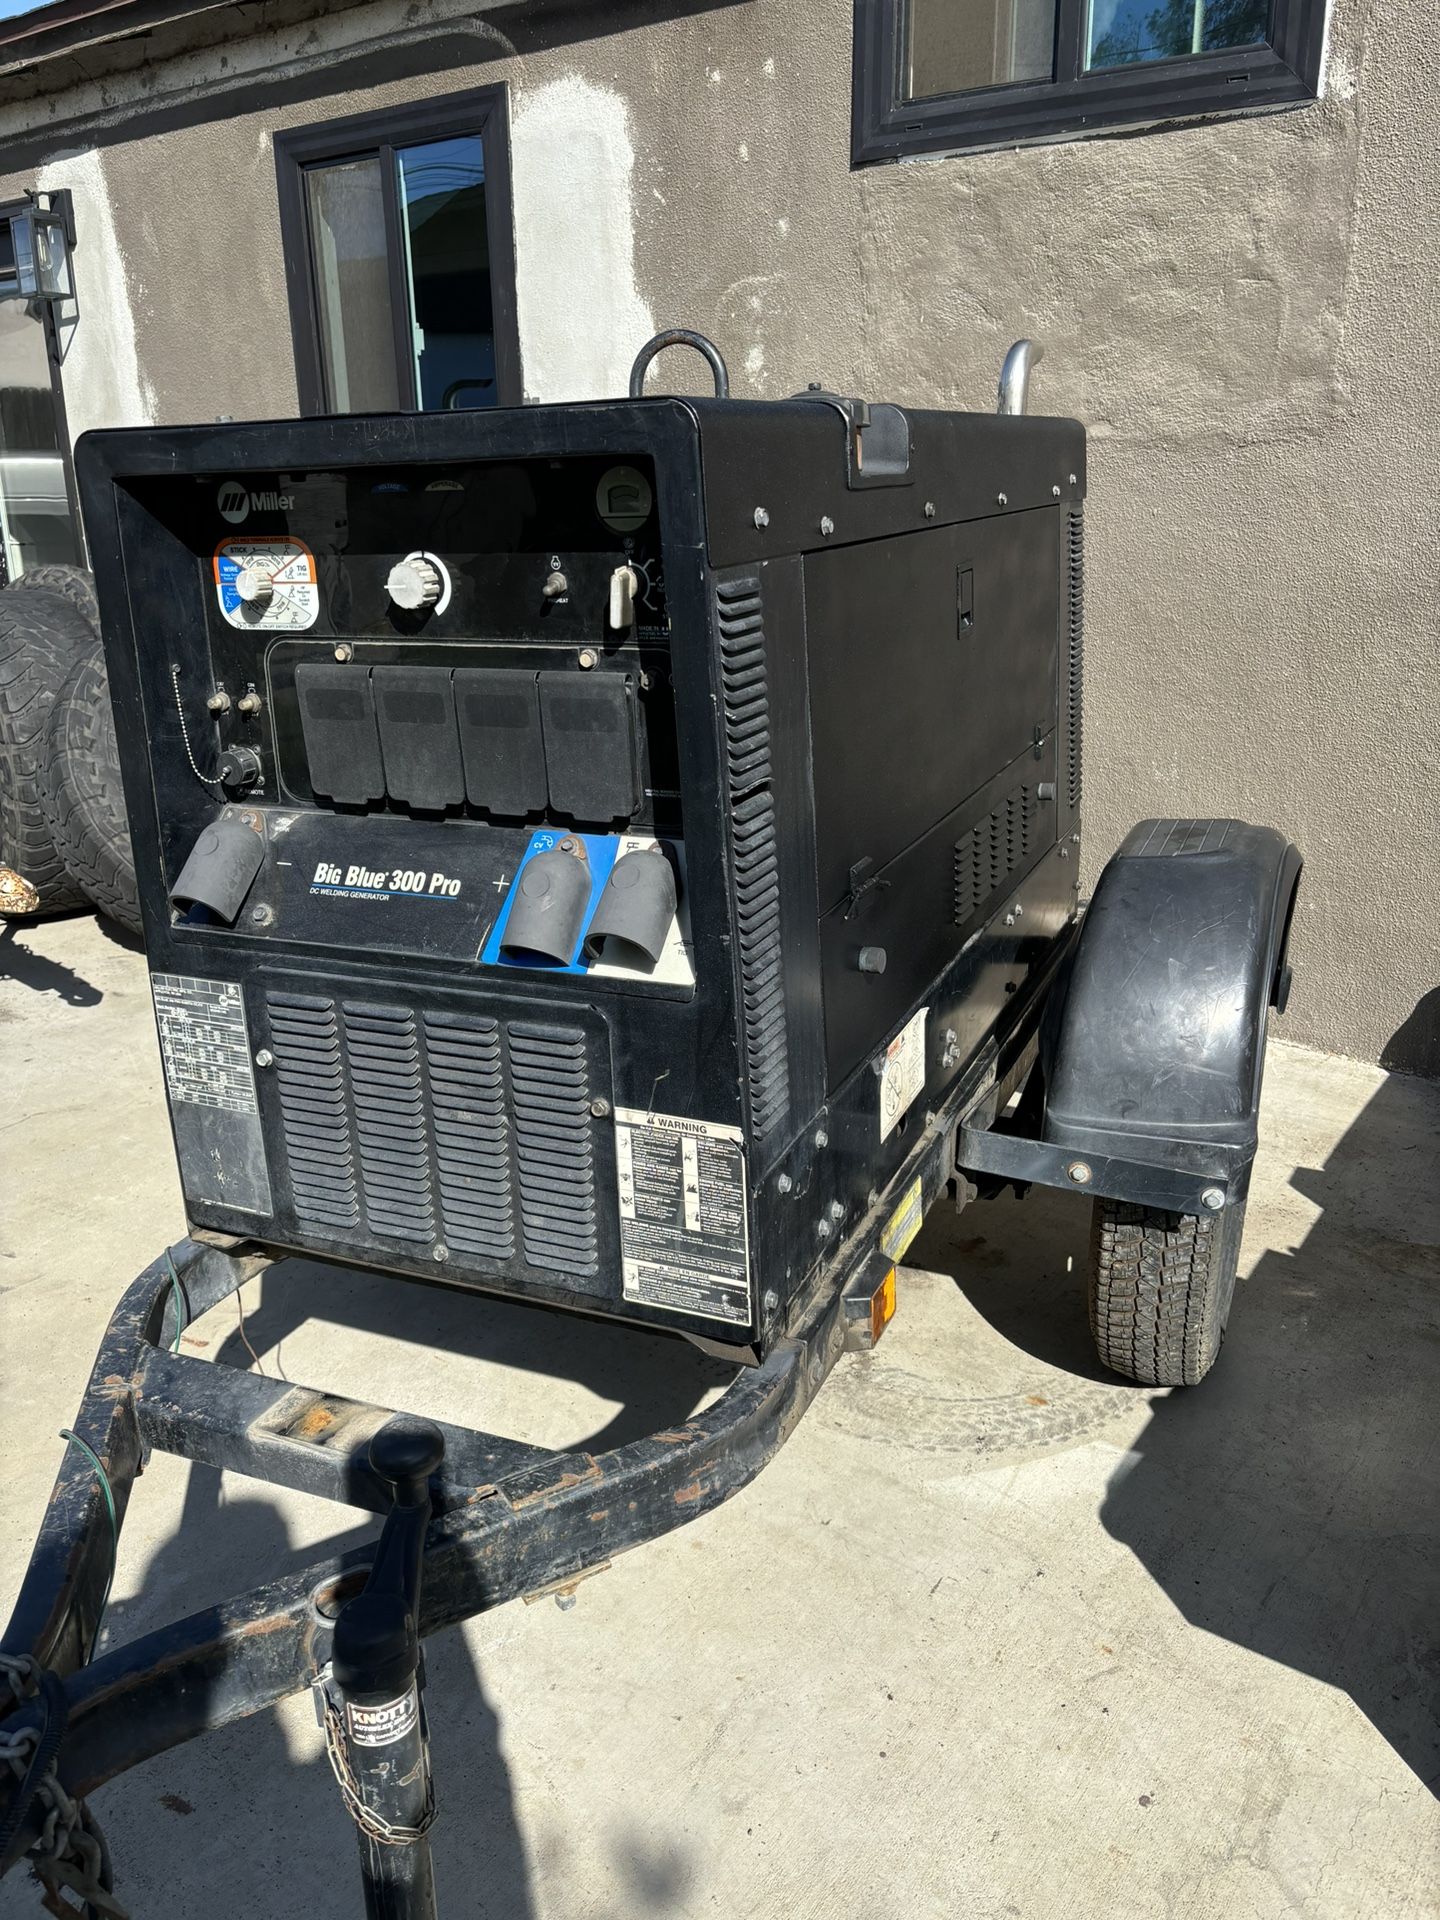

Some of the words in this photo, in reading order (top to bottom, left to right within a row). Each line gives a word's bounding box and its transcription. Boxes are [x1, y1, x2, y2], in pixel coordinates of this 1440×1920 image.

[250, 491, 295, 511] Miller
[388, 870, 427, 893] 300
[428, 873, 461, 896] Pro
[309, 887, 319, 895] DC
[320, 888, 349, 898] WELDING
[350, 891, 390, 901] GENERATOR
[658, 1118, 708, 1134] WARNING
[352, 1700, 408, 1724] KNOTT
